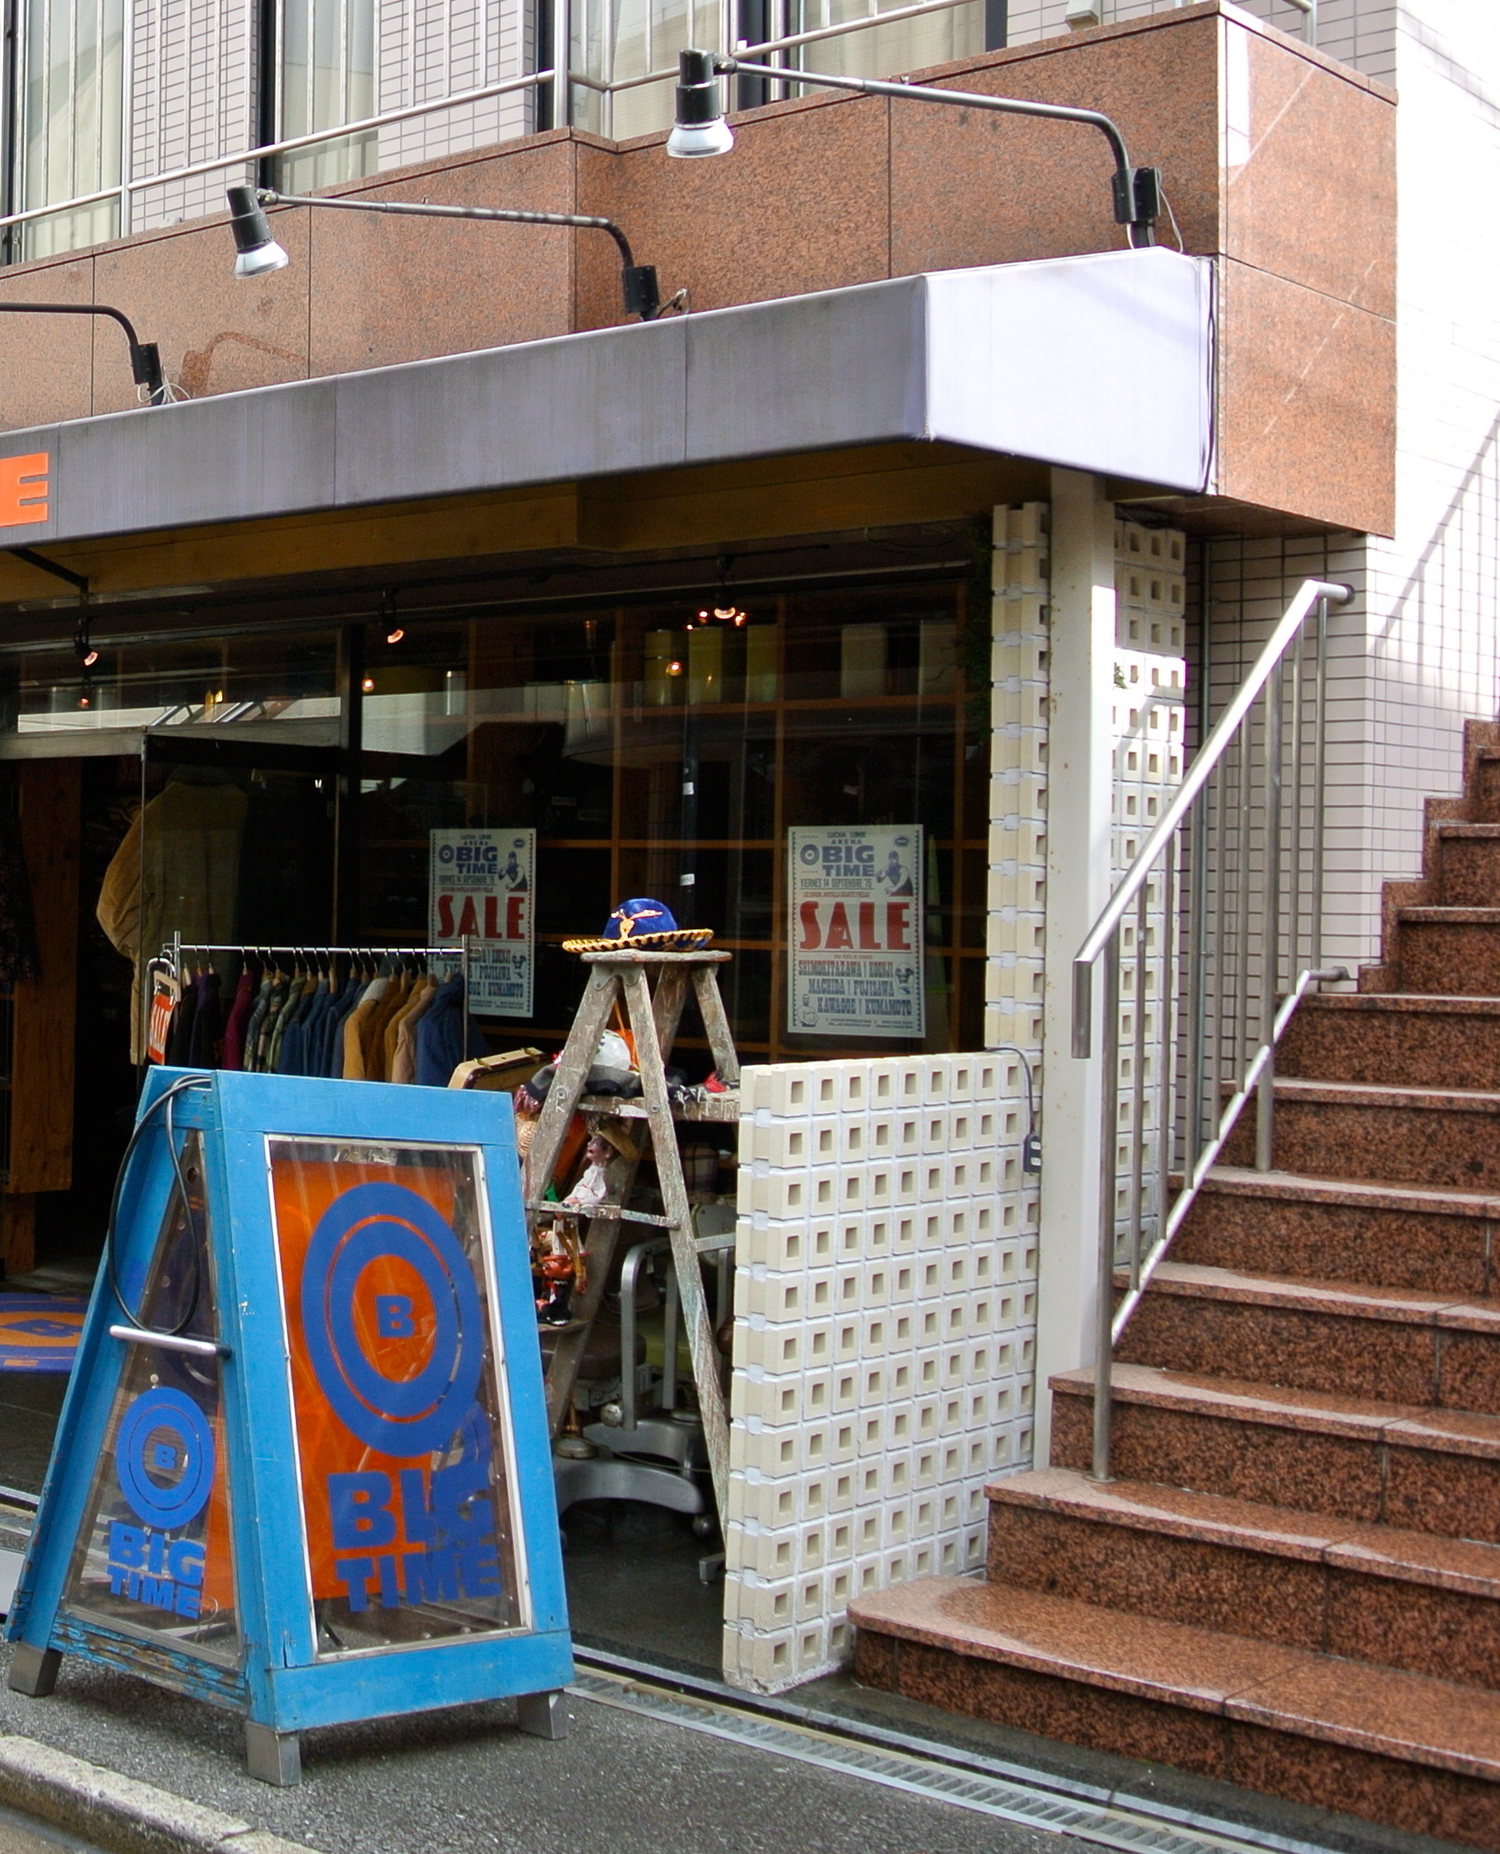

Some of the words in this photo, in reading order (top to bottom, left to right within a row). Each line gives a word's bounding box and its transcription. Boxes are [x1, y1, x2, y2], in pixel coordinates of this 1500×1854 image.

[456, 846, 498, 862] BIG
[456, 863, 498, 874] TIME
[822, 845, 875, 863] BIG
[822, 864, 875, 877] TIME
[437, 894, 525, 939] SALE
[799, 900, 911, 950] SALE
[808, 978, 846, 994] MACHIDA
[853, 979, 895, 997] FUJISAWA
[817, 997, 856, 1014] KAWAGOE
[864, 999, 912, 1016] KUMAMOTO
[376, 1294, 414, 1339] B
[154, 1443, 177, 1469] B
[327, 1463, 493, 1550] BIG
[109, 1521, 206, 1586] BIG
[107, 1563, 201, 1620] TIME
[335, 1543, 501, 1613] TIME
